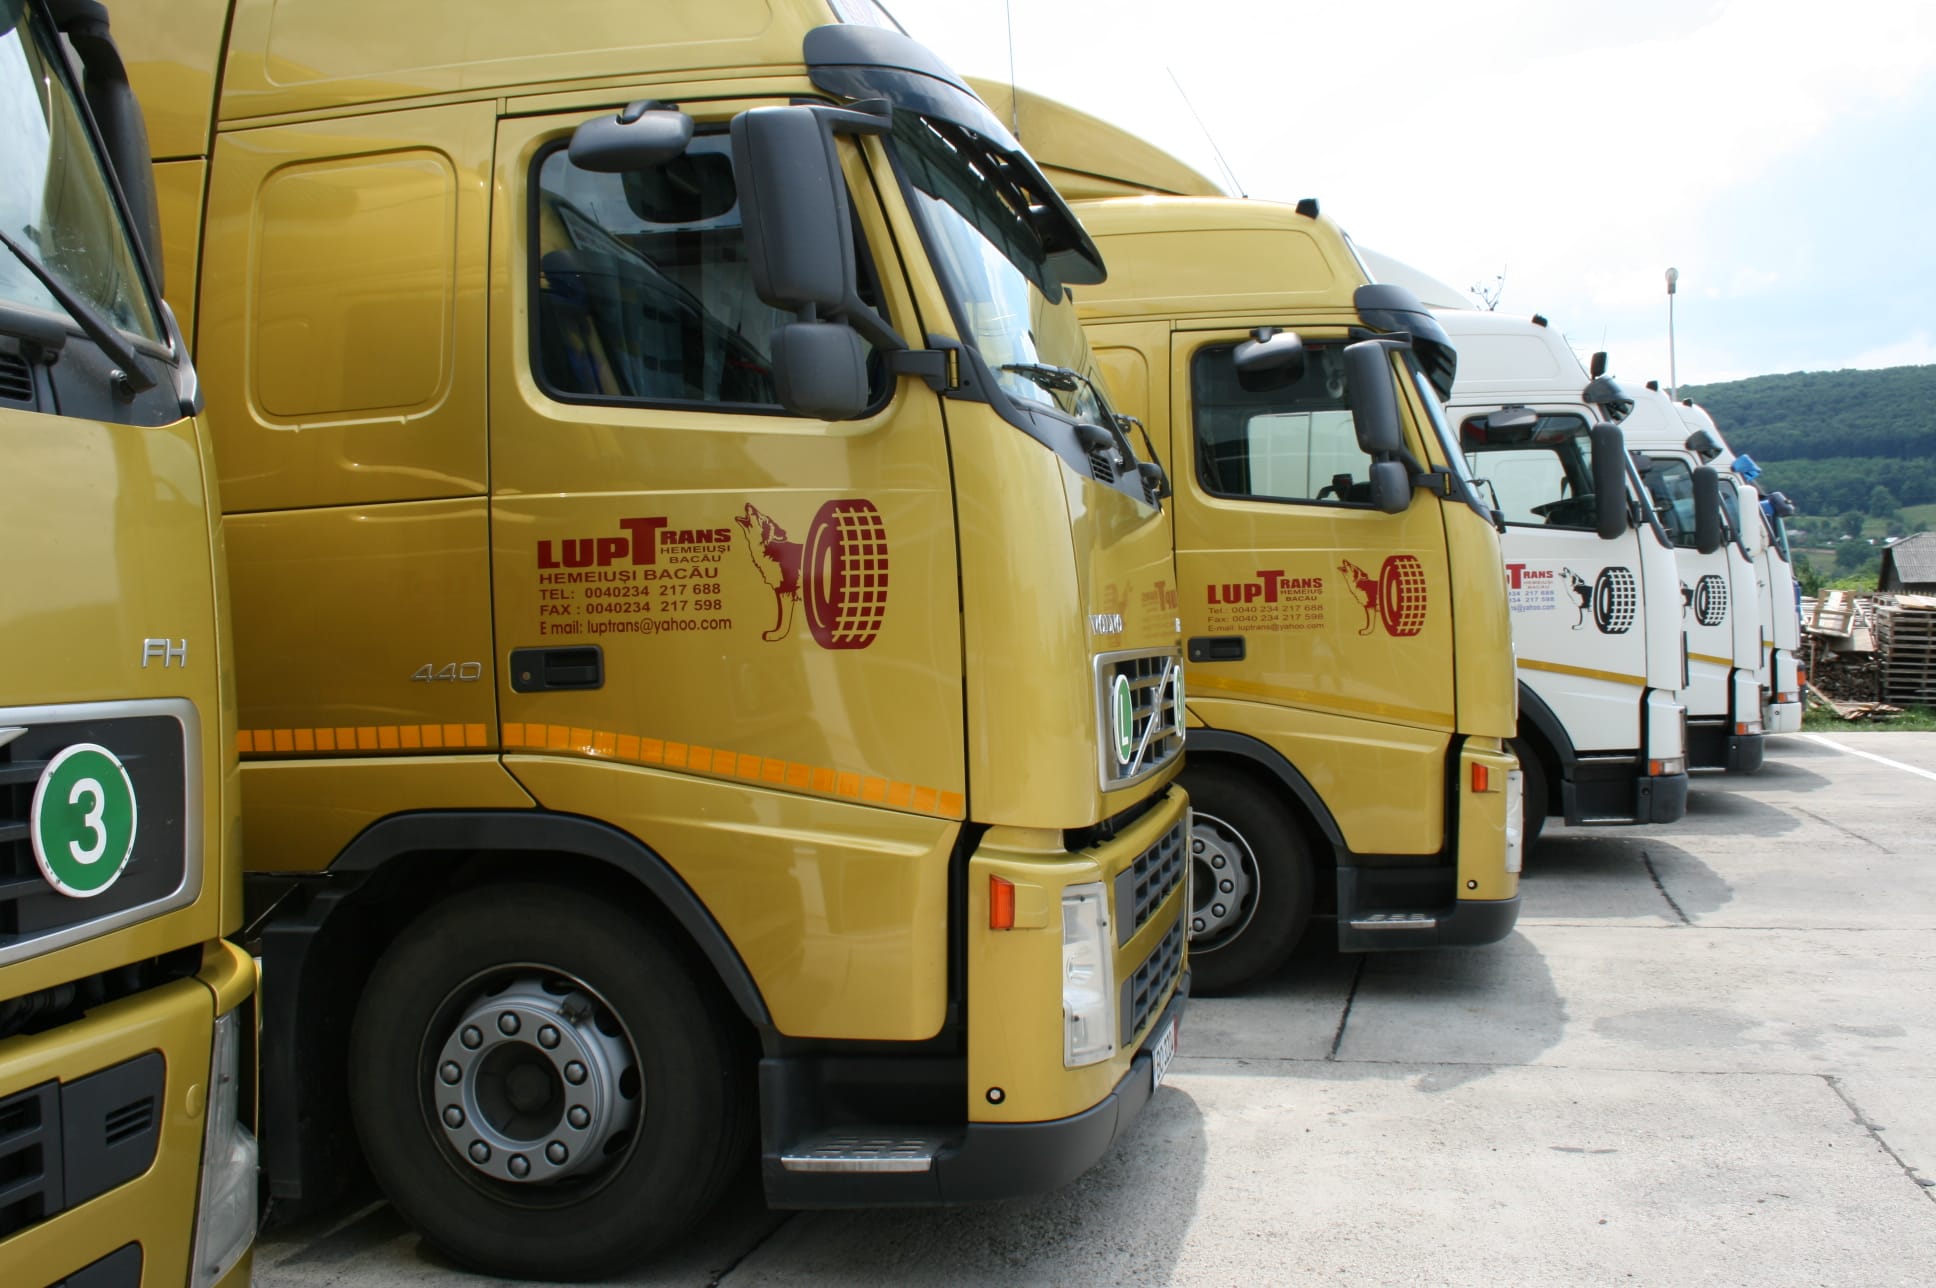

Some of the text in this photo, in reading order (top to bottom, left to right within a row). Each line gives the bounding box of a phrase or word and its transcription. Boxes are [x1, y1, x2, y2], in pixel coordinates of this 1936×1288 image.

[537, 516, 731, 569] LUPTRANS
[539, 583, 721, 600] TEL: 0040234 217 688
[586, 602, 650, 615] 0040234
[660, 600, 688, 612] 217
[694, 599, 722, 611] 598
[551, 620, 582, 634] mail:
[587, 617, 732, 636] luptrans@yahoo.com
[142, 638, 187, 668] FH
[411, 662, 481, 683] 440
[1120, 693, 1128, 746] L
[69, 777, 107, 865] 3
